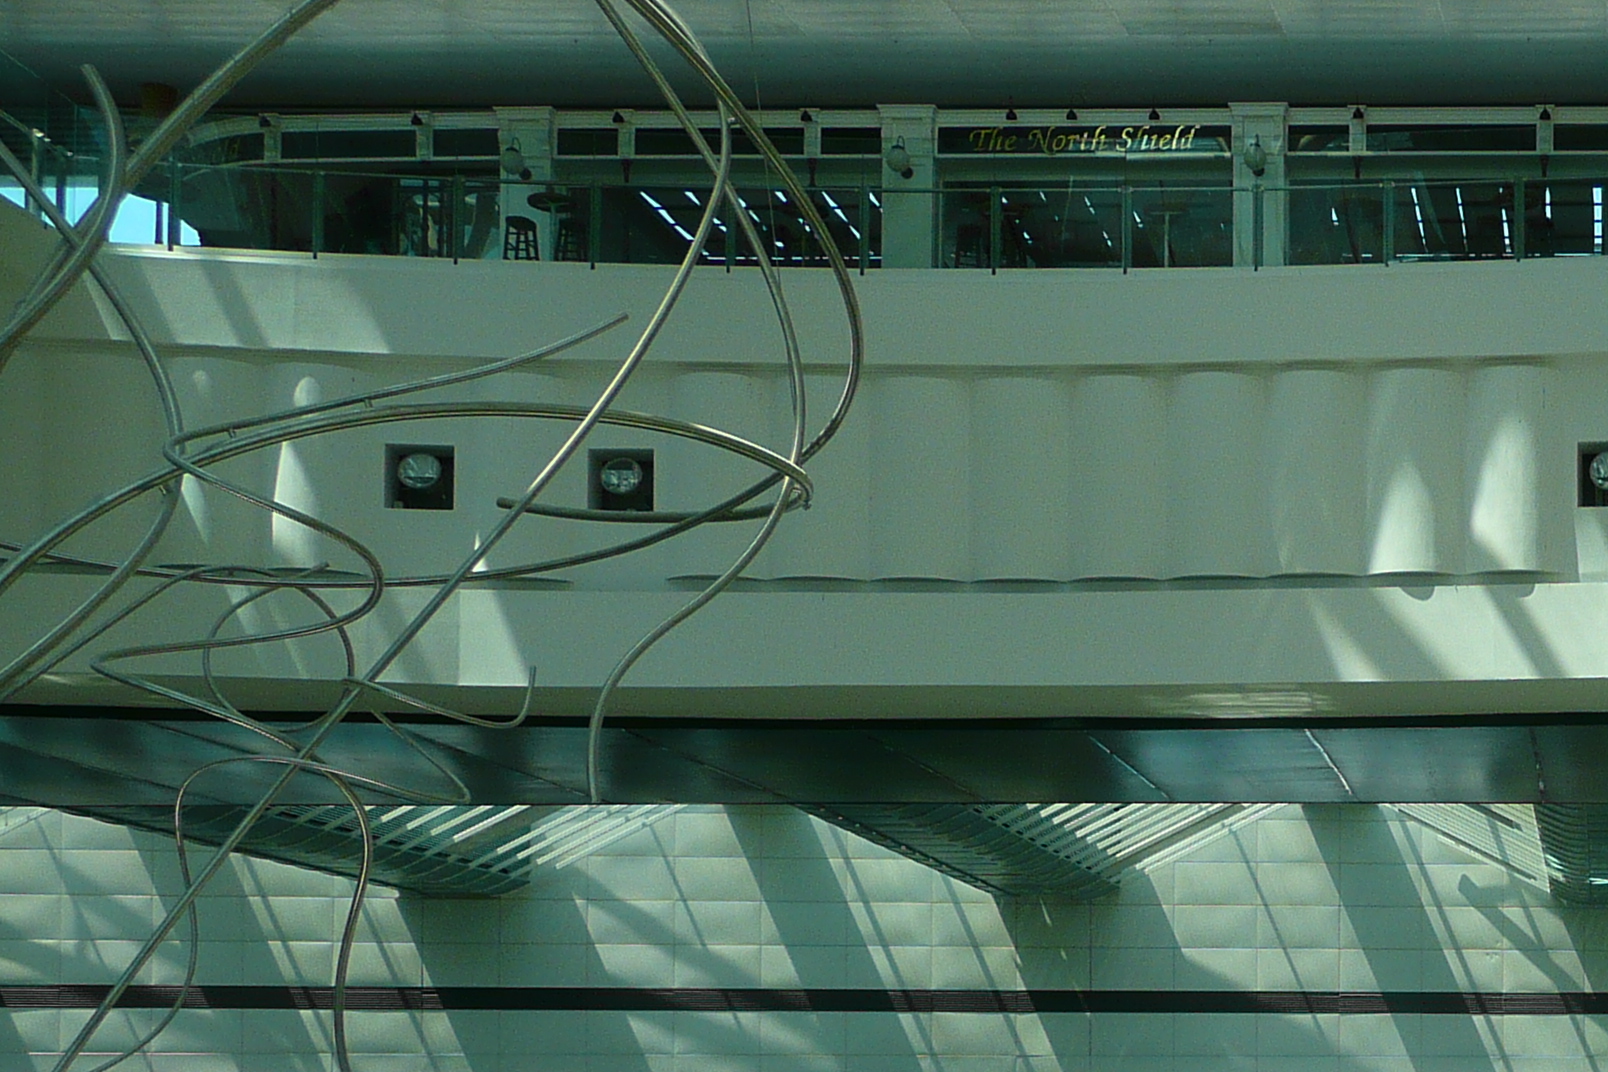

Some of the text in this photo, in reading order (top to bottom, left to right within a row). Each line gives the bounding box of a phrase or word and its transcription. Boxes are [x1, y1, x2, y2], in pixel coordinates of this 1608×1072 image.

[968, 124, 1201, 156] The North Shield
